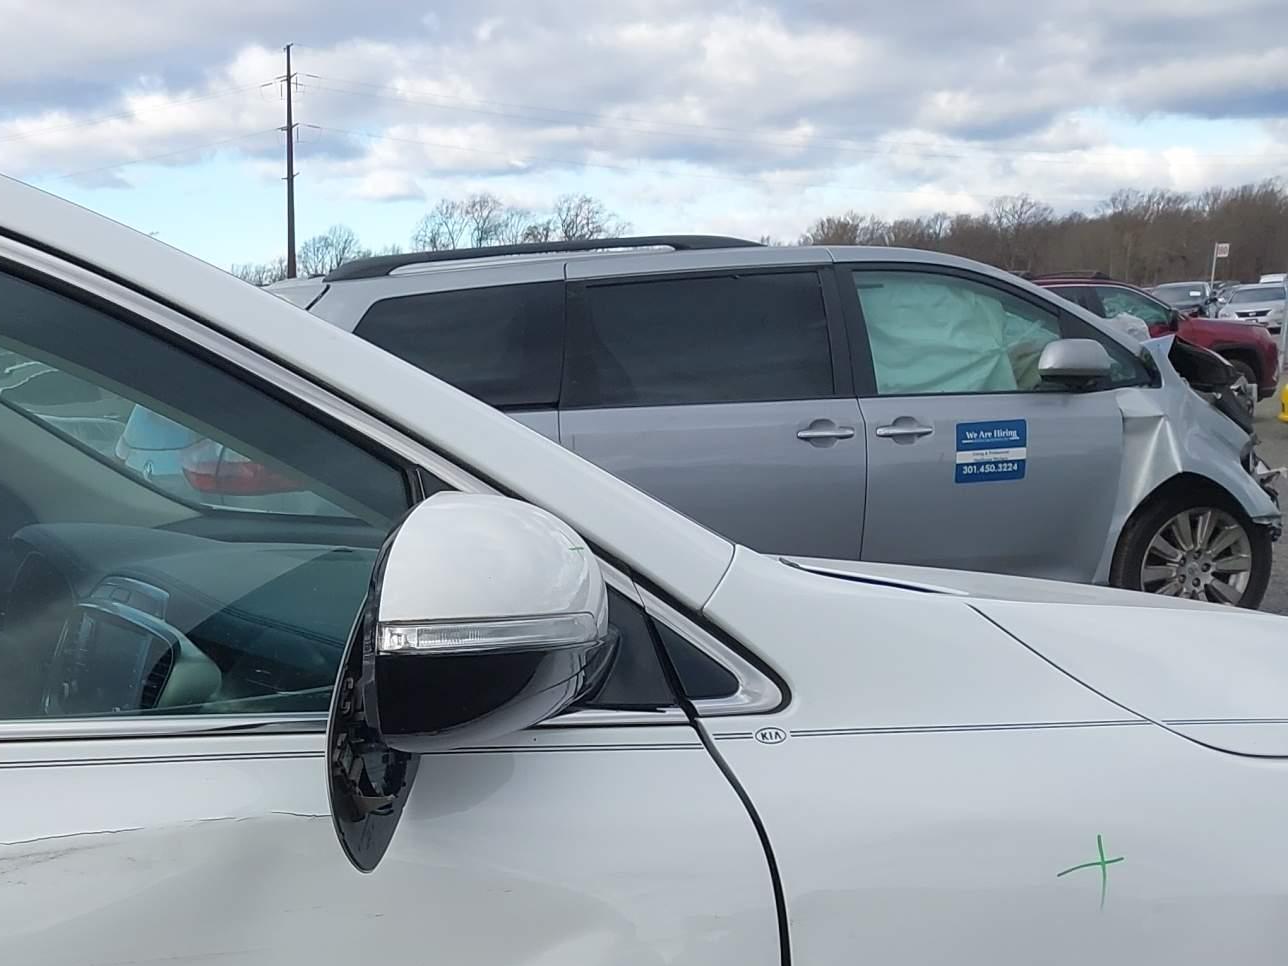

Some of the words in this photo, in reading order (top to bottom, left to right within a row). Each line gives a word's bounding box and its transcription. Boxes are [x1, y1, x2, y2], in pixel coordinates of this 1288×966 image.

[966, 431, 978, 439] We
[979, 430, 992, 438] Are
[993, 428, 1018, 438] Hiring
[963, 463, 1018, 474] 301.450.3224
[760, 731, 782, 741] KIA
